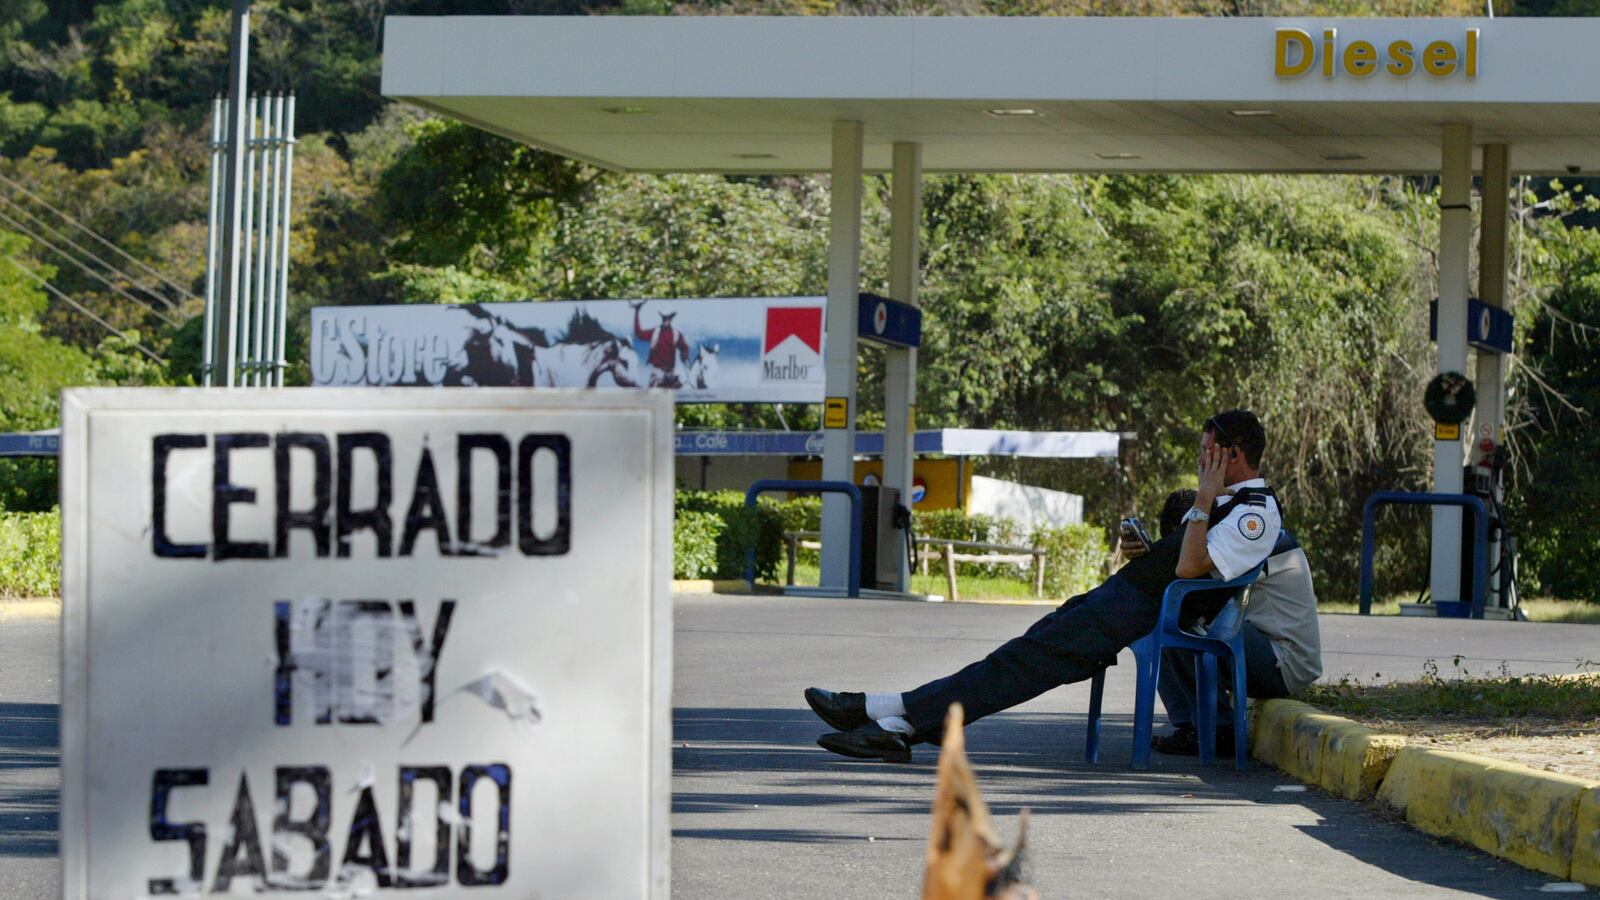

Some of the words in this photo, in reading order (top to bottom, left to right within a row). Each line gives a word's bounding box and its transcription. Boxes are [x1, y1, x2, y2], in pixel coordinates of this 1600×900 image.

[1274, 27, 1480, 78] Diesel
[151, 432, 572, 561] CERRADO
[148, 763, 512, 895] SABADO
